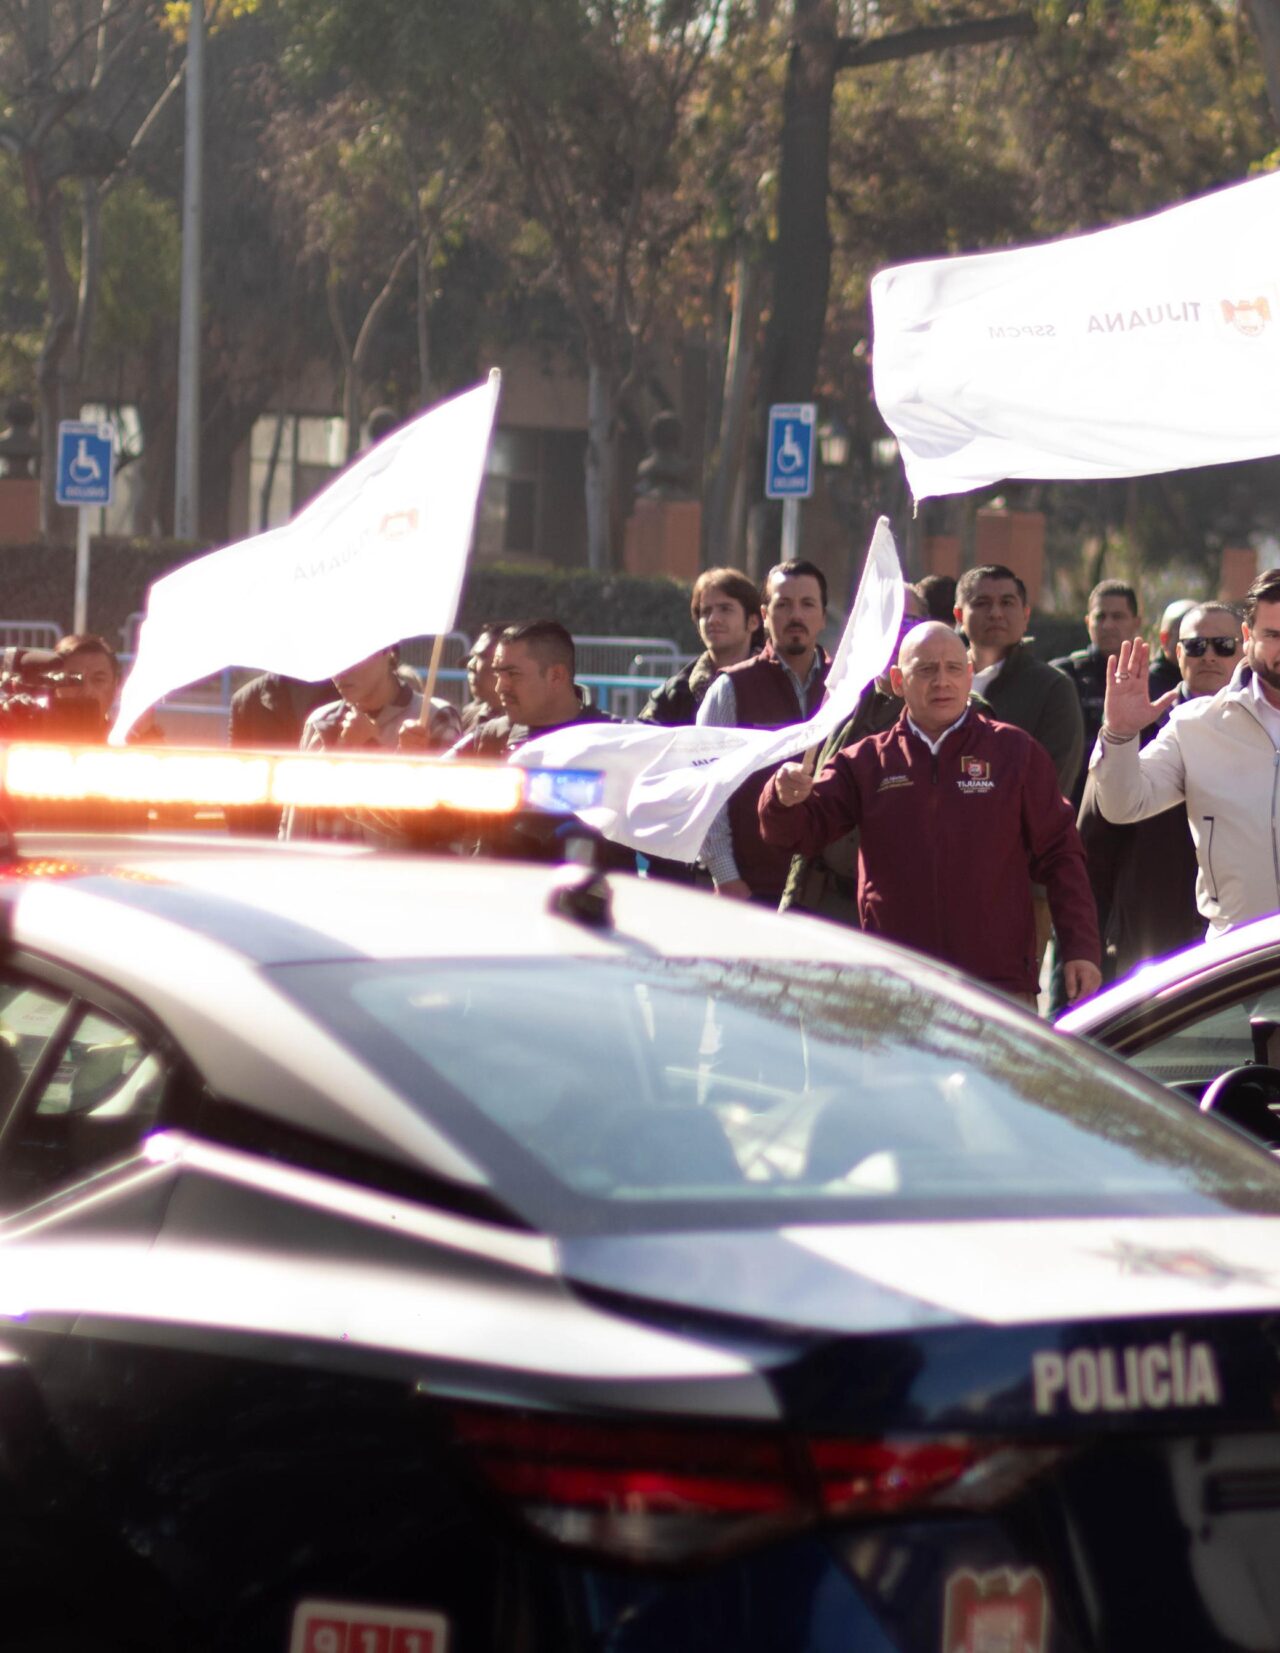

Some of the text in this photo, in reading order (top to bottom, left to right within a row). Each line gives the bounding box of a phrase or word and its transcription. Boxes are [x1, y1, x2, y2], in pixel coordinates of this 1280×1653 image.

[957, 780, 994, 788] TIJUANA
[1031, 1332, 1220, 1415] POLICÍA
[313, 1626, 422, 1653] 911
